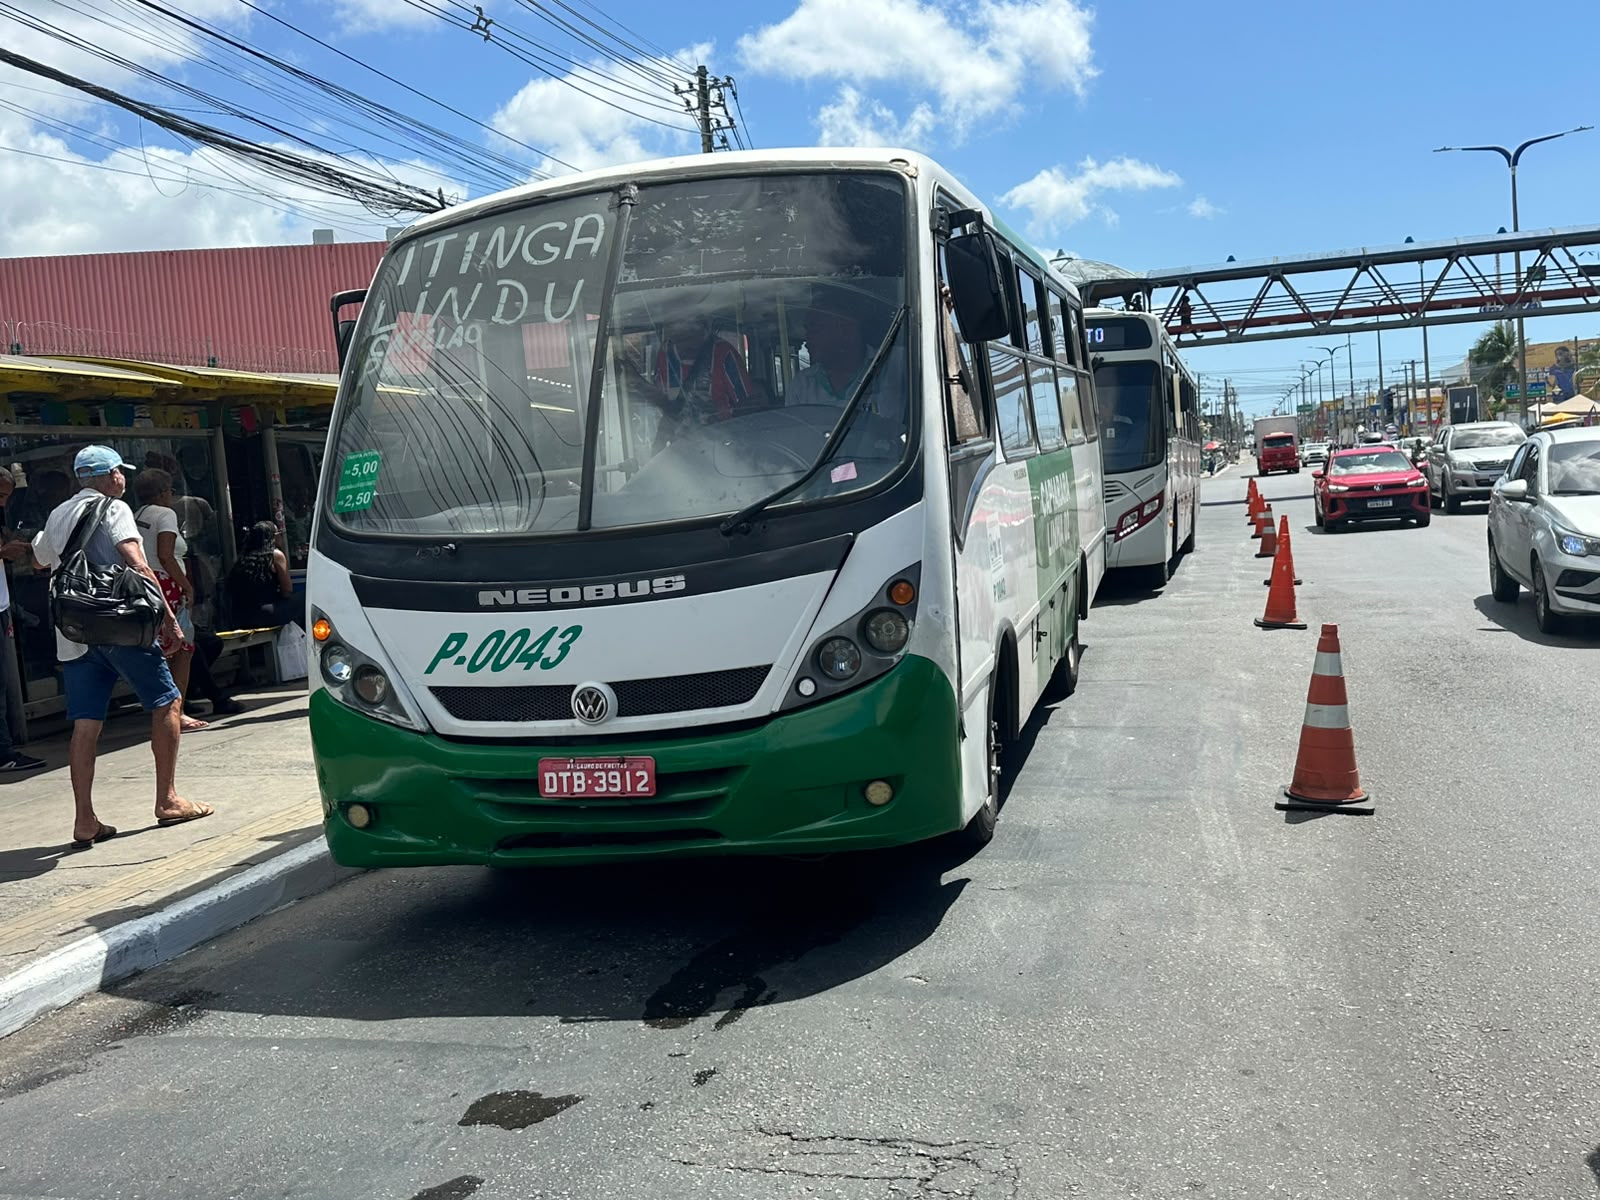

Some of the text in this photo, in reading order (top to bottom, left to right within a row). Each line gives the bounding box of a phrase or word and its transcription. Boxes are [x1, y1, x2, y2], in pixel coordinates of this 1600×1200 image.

[397, 213, 605, 286] ITINGA
[351, 460, 378, 477] 5,00
[344, 491, 371, 508] 2,50
[478, 575, 686, 606] NEOBUS
